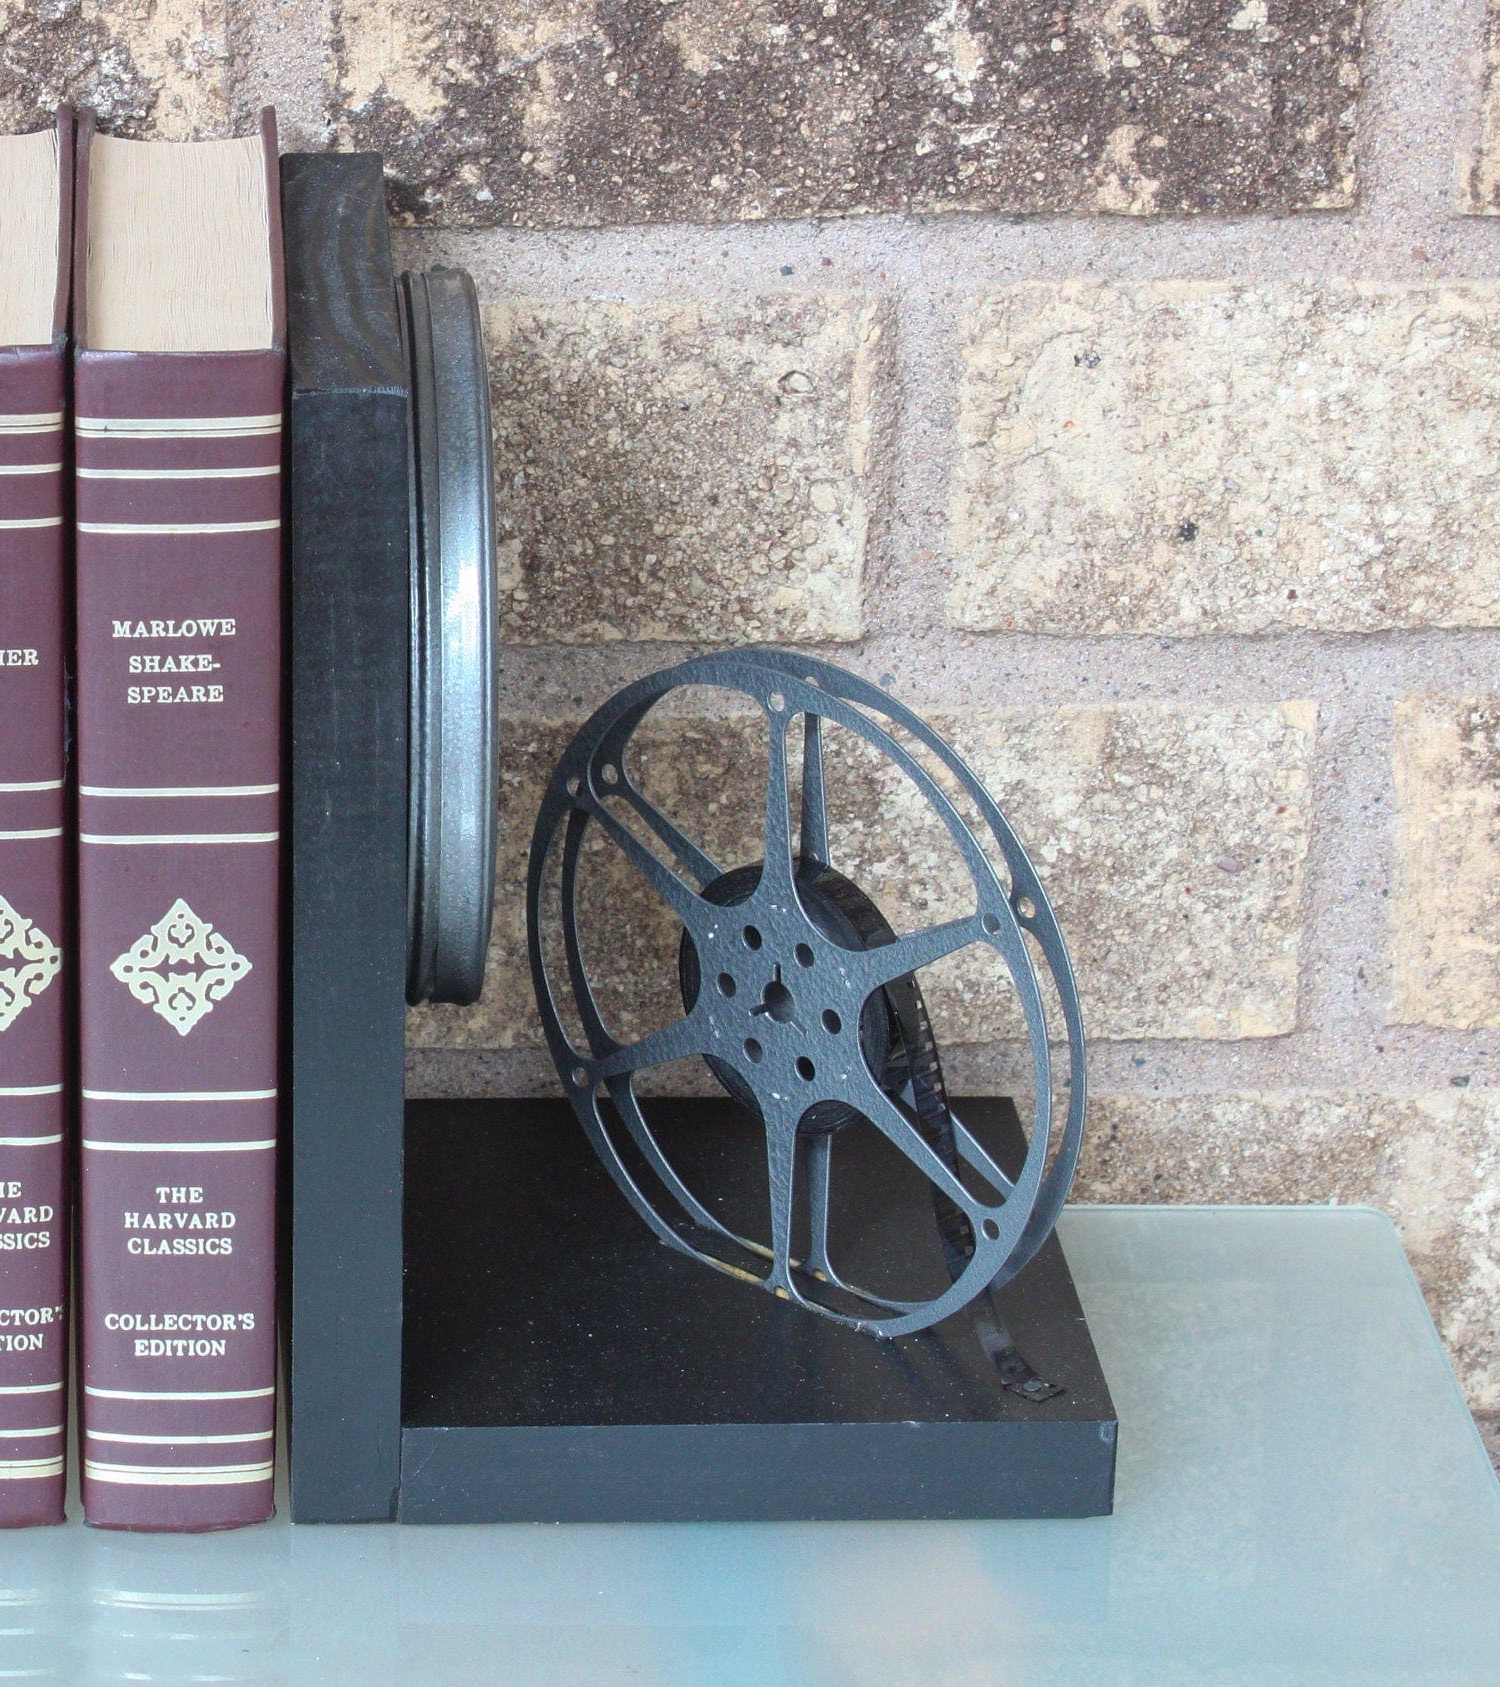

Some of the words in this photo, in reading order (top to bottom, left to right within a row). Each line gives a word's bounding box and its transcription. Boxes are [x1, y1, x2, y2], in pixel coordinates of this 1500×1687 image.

[111, 618, 236, 638] MARLOWE
[128, 654, 221, 674] SHAKE-
[127, 684, 224, 704] SPEARE
[155, 1186, 204, 1204] THE
[124, 1211, 236, 1230] HARVARD
[127, 1237, 233, 1256] CLASSICS
[104, 1312, 255, 1331] COLLECTOR'S
[134, 1339, 227, 1357] EDITION
